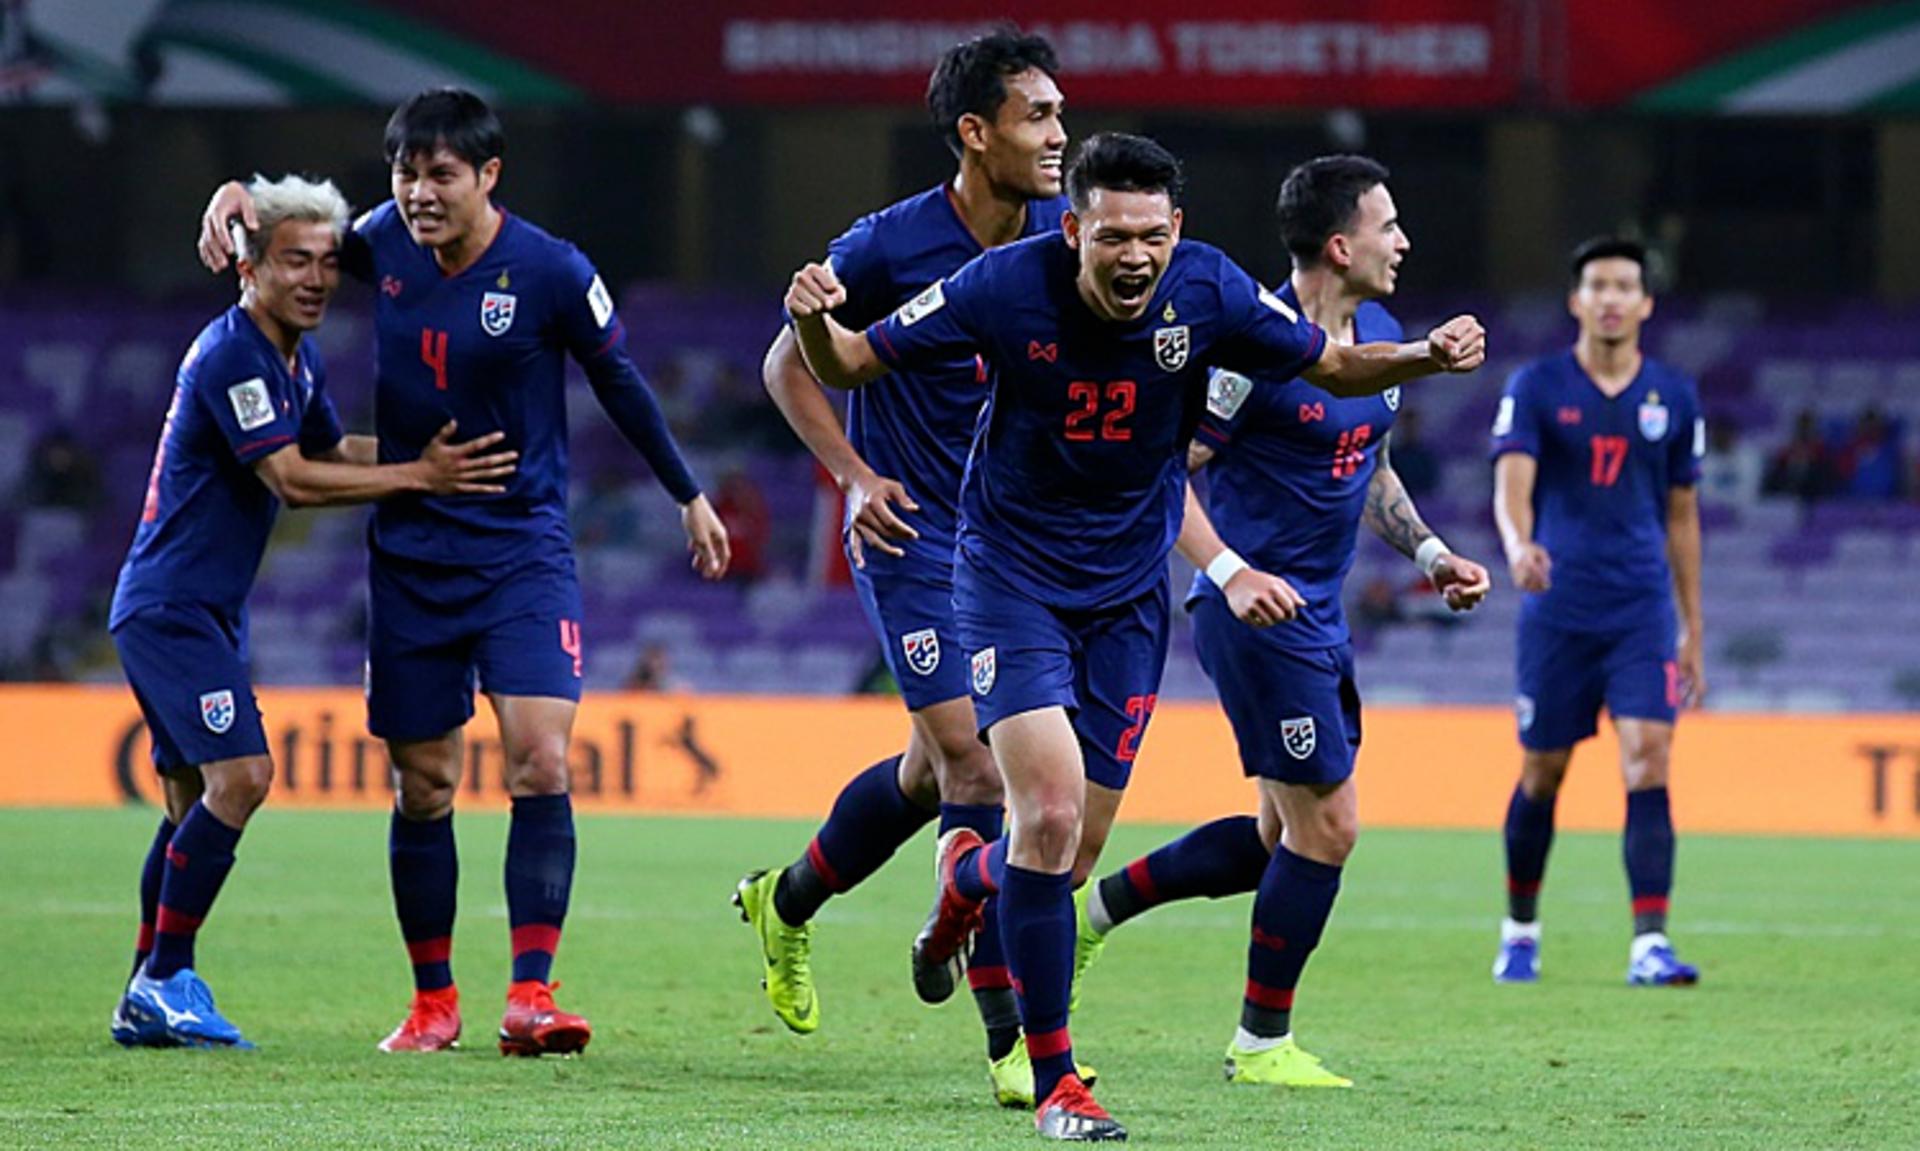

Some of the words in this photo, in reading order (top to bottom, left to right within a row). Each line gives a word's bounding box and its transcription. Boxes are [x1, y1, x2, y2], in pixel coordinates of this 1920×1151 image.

[421, 327, 448, 390] 4
[1064, 380, 1137, 441] 22
[1590, 434, 1628, 486] 17
[560, 618, 582, 678] 4
[1116, 693, 1158, 762] 2
